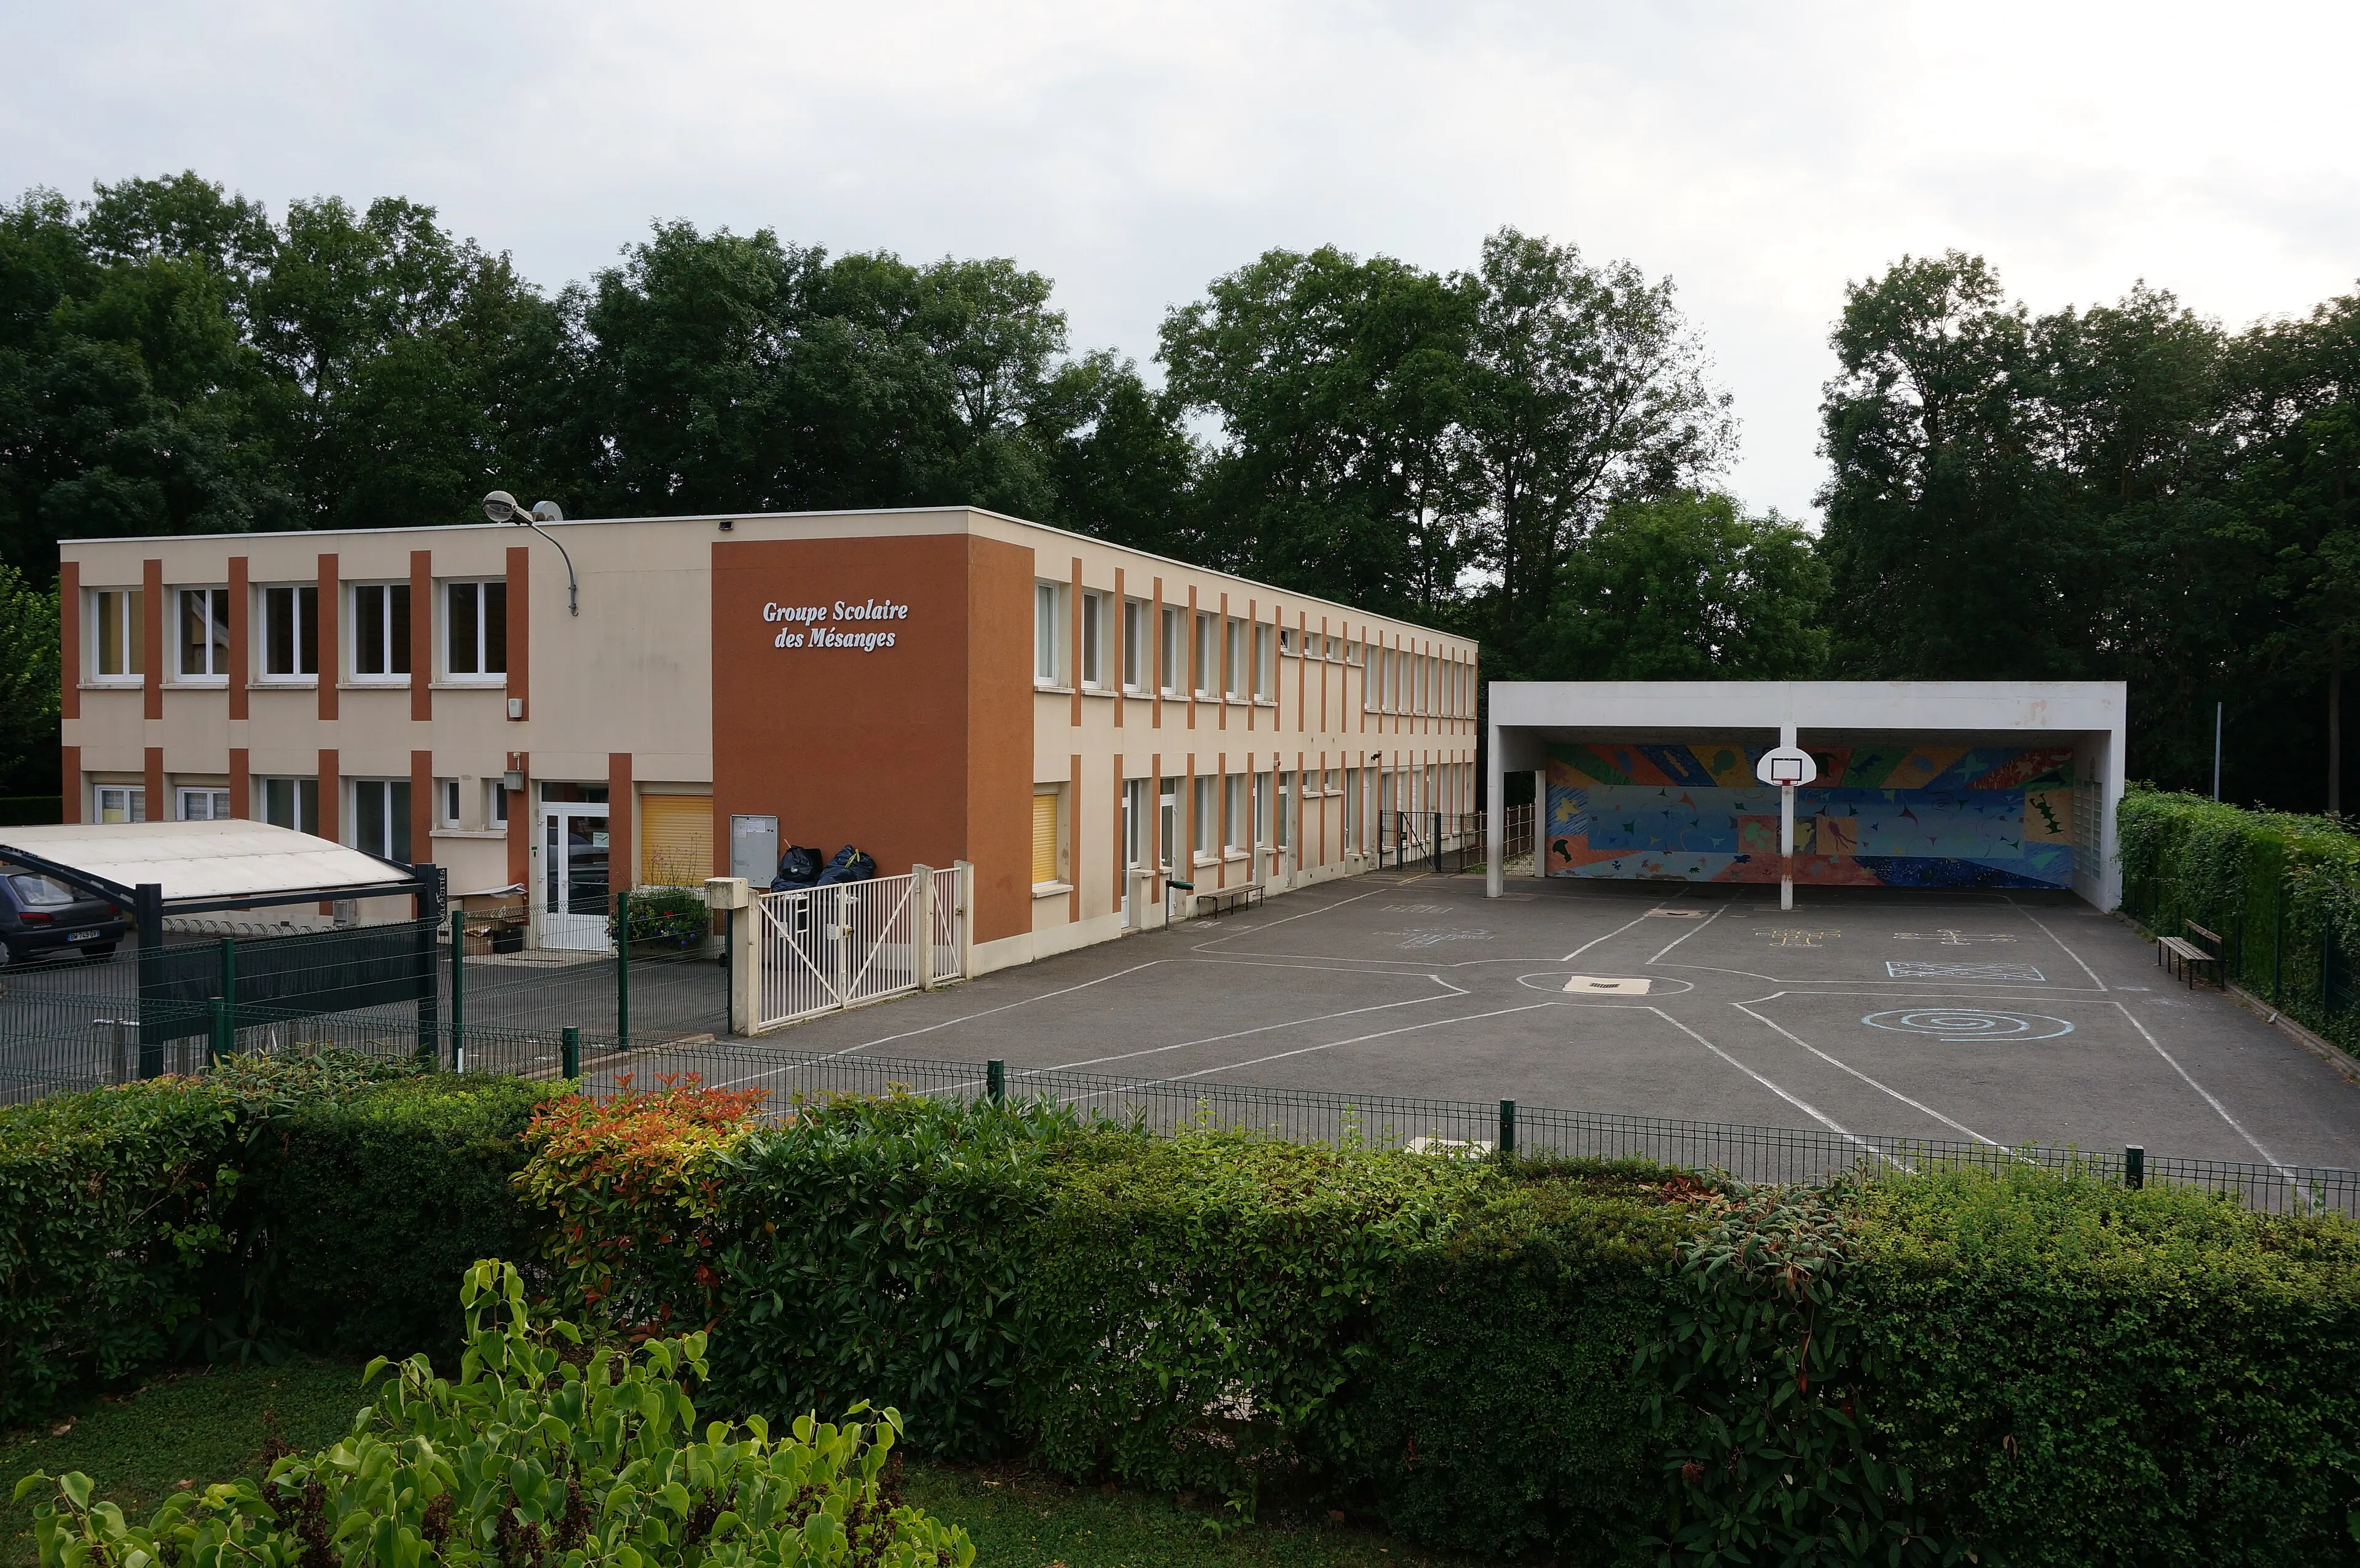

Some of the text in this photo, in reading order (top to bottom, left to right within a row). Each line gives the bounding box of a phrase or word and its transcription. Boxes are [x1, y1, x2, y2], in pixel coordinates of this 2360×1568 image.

[763, 598, 908, 625] Groupe Scolaire
[775, 627, 895, 652] des Mésanges
